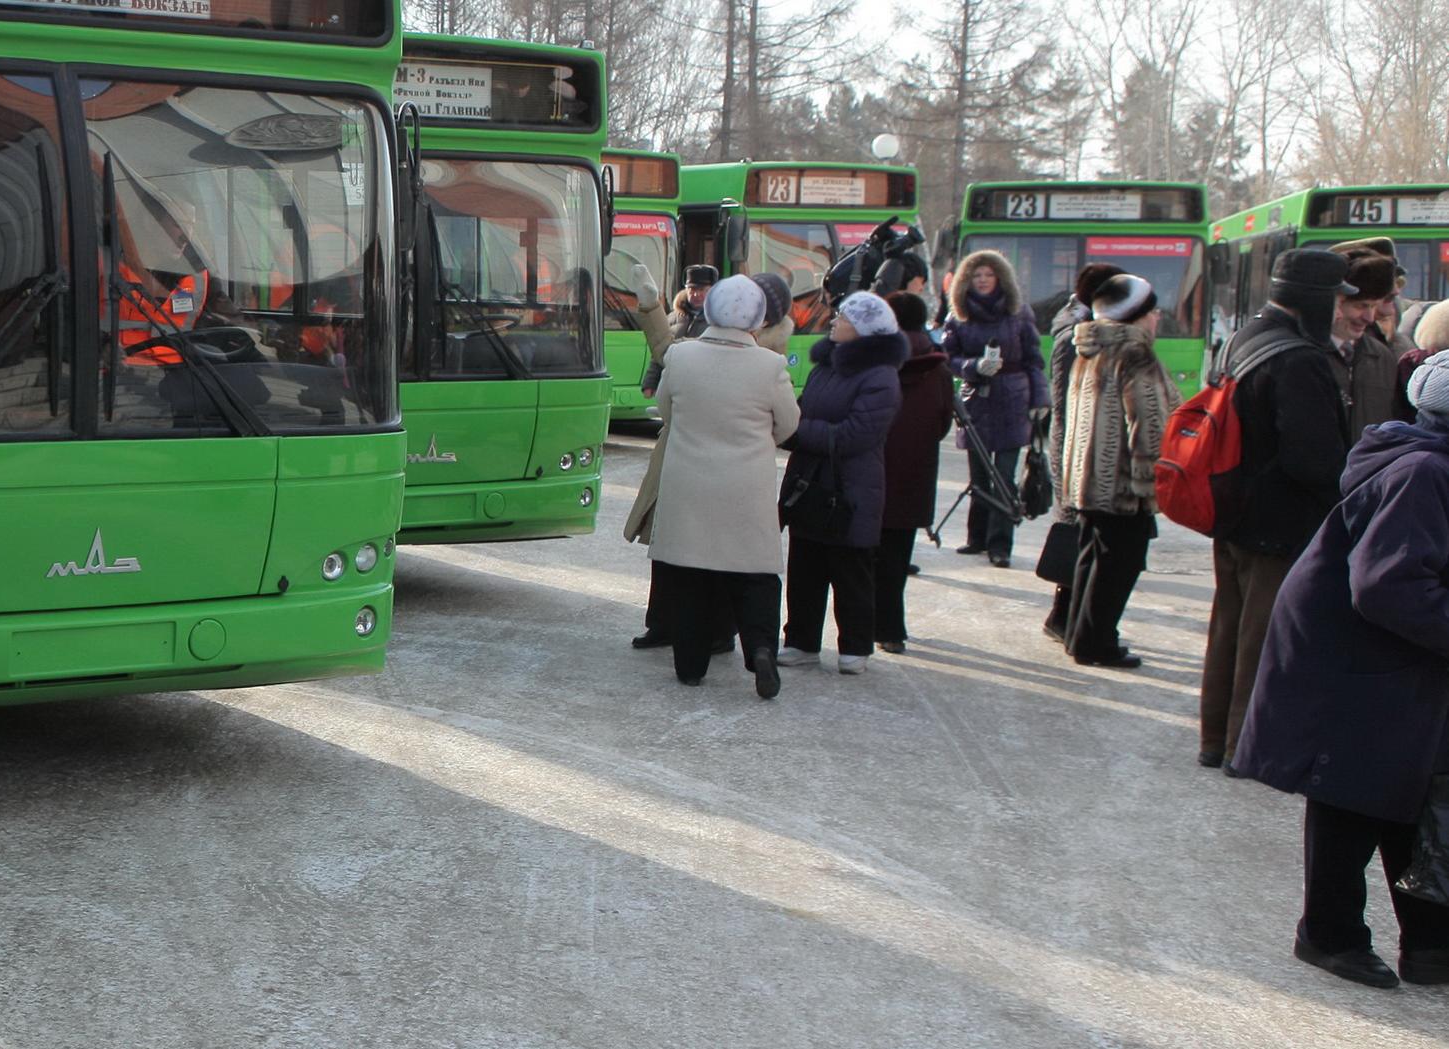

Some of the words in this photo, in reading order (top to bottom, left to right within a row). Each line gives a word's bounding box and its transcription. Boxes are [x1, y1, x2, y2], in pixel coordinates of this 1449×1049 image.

[769, 175, 791, 202] 23
[1009, 194, 1038, 217] 23
[1351, 199, 1382, 223] 45
